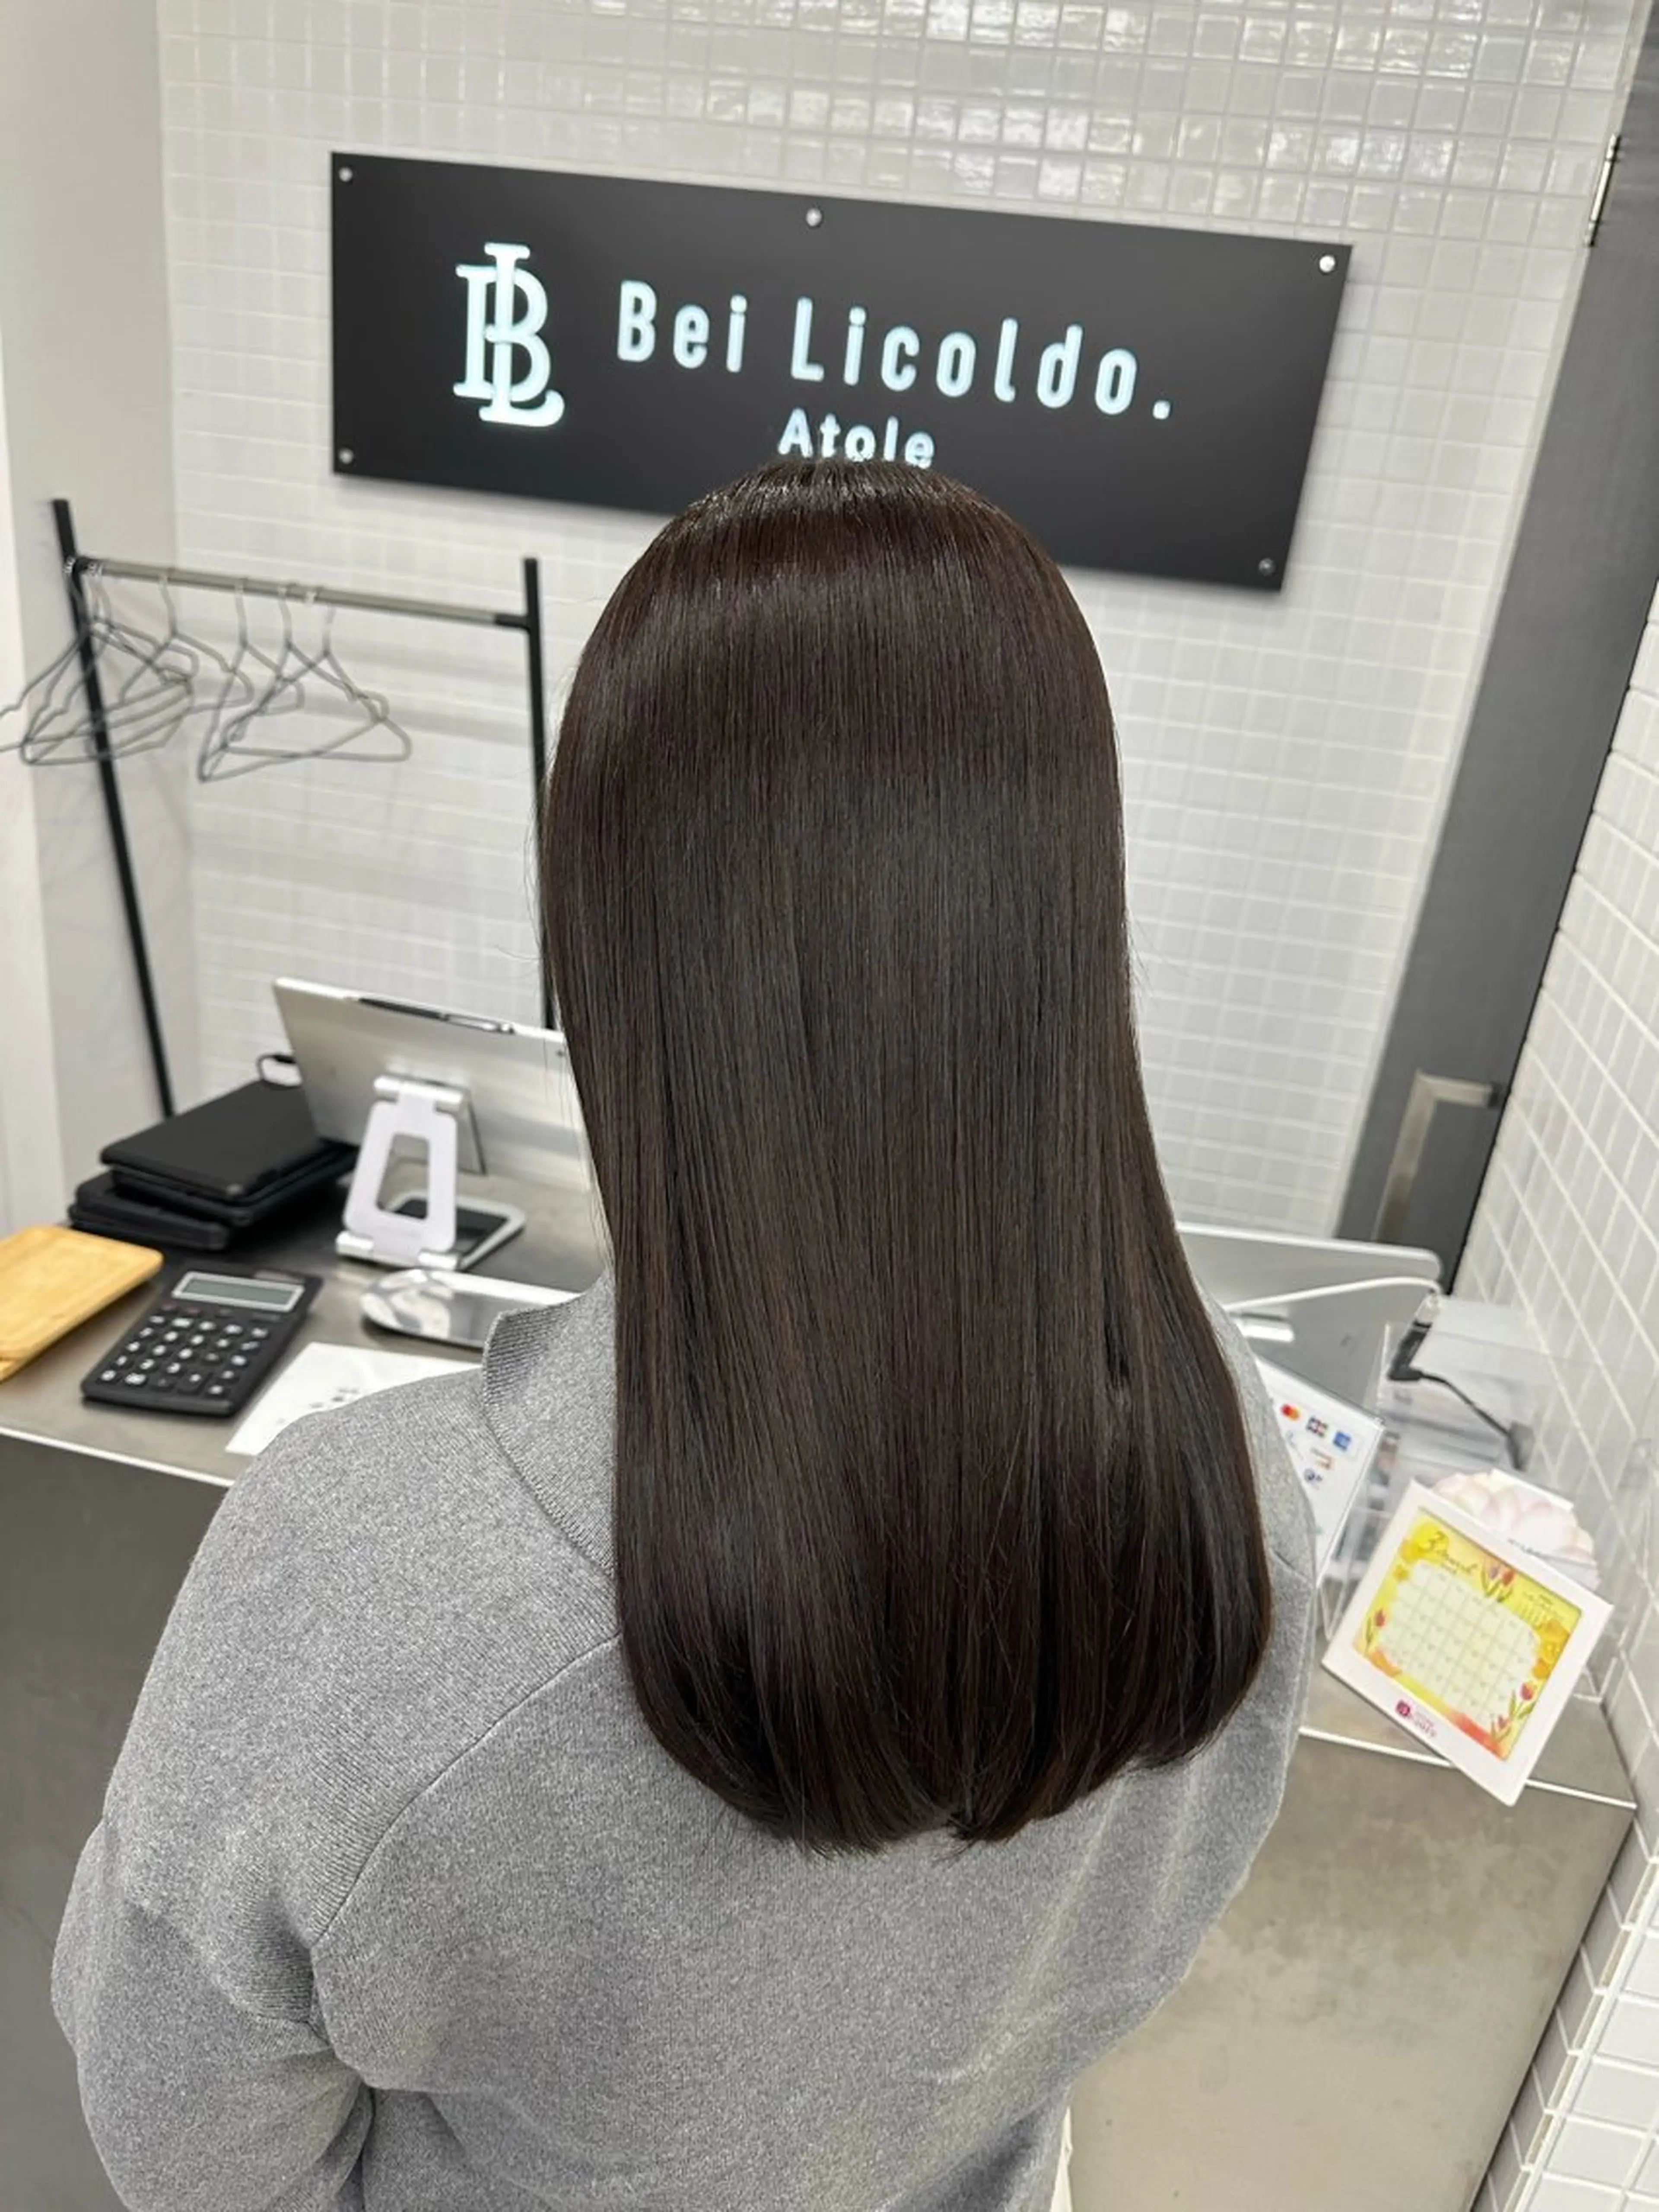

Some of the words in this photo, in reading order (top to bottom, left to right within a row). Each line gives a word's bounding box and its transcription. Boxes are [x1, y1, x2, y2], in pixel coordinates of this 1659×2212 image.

[617, 280, 747, 373] Bei
[790, 296, 1171, 420] Licoldo.
[777, 407, 934, 470] Atole
